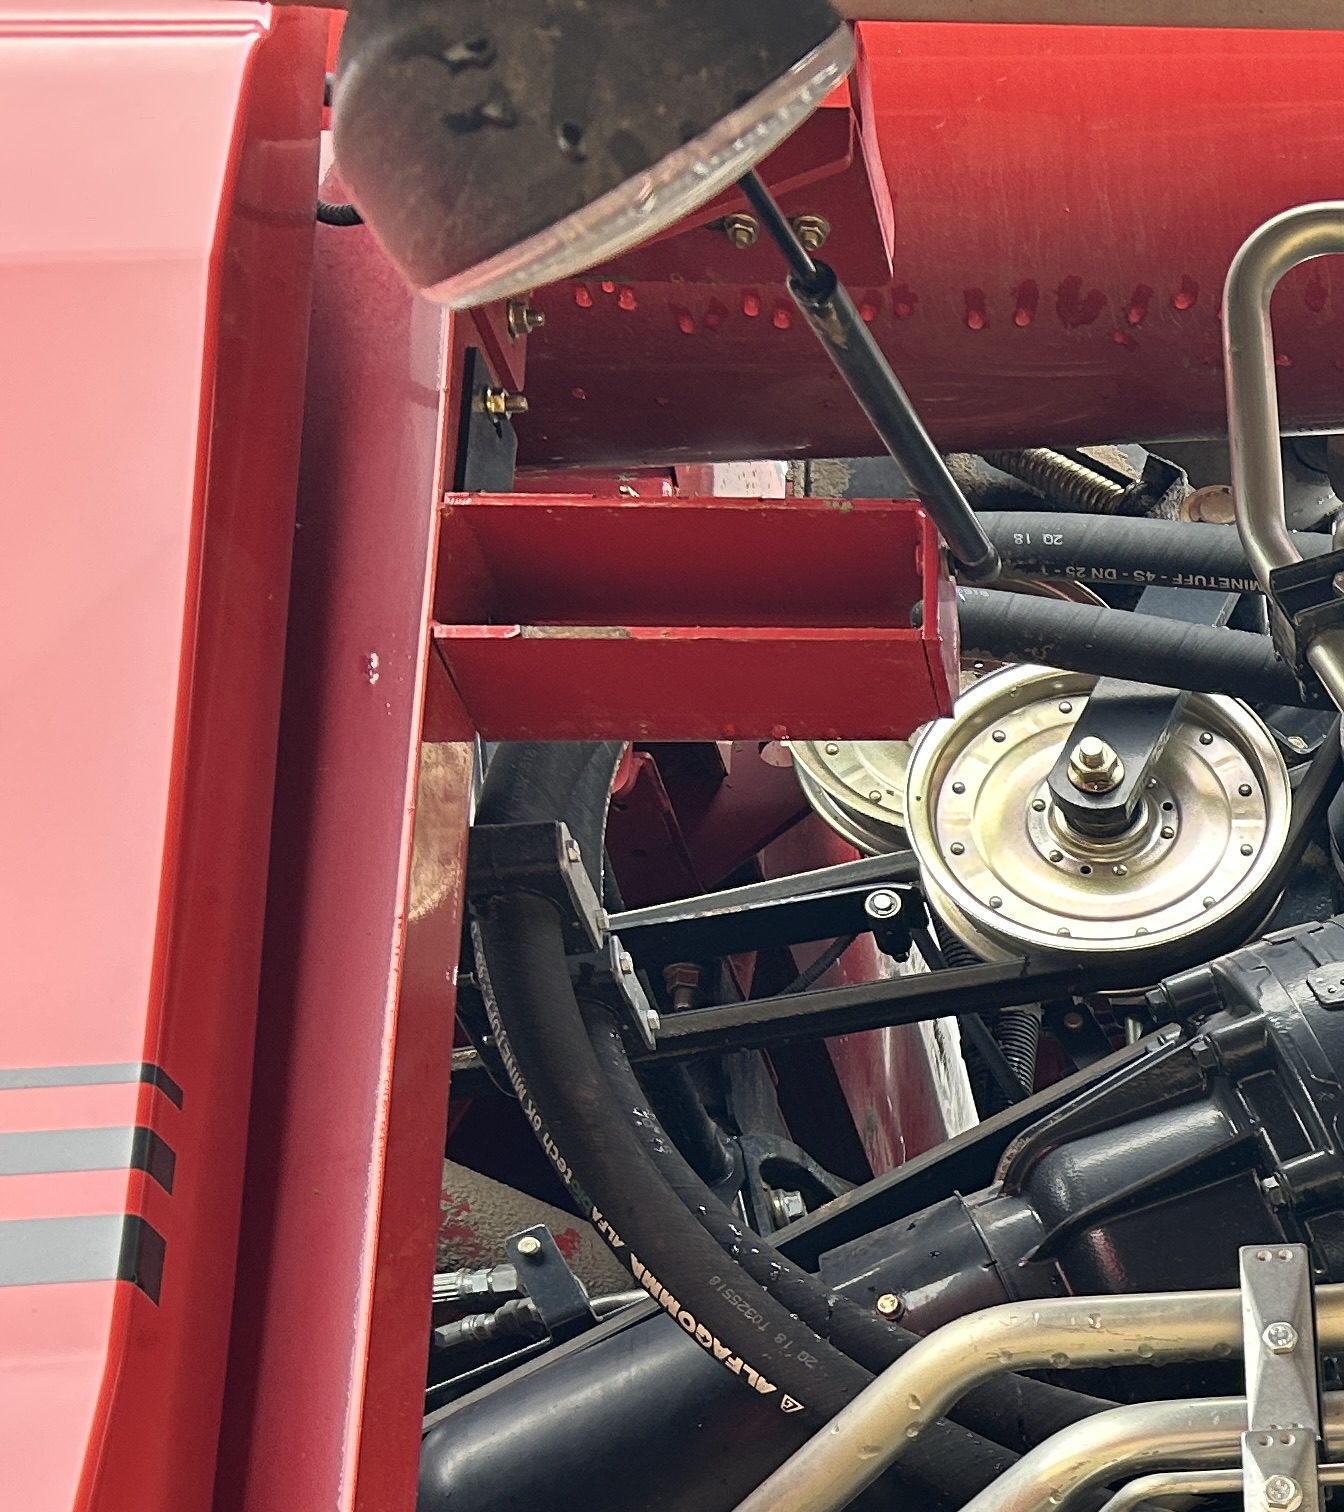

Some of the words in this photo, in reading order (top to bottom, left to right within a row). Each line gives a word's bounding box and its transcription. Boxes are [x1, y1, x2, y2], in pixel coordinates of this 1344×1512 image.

[1091, 567, 1118, 580] DN
[1133, 569, 1157, 582] 4S
[1171, 573, 1264, 592] MINETUFF
[590, 1205, 626, 1248] ALFA
[630, 1252, 777, 1395] ALFAGOMMA
